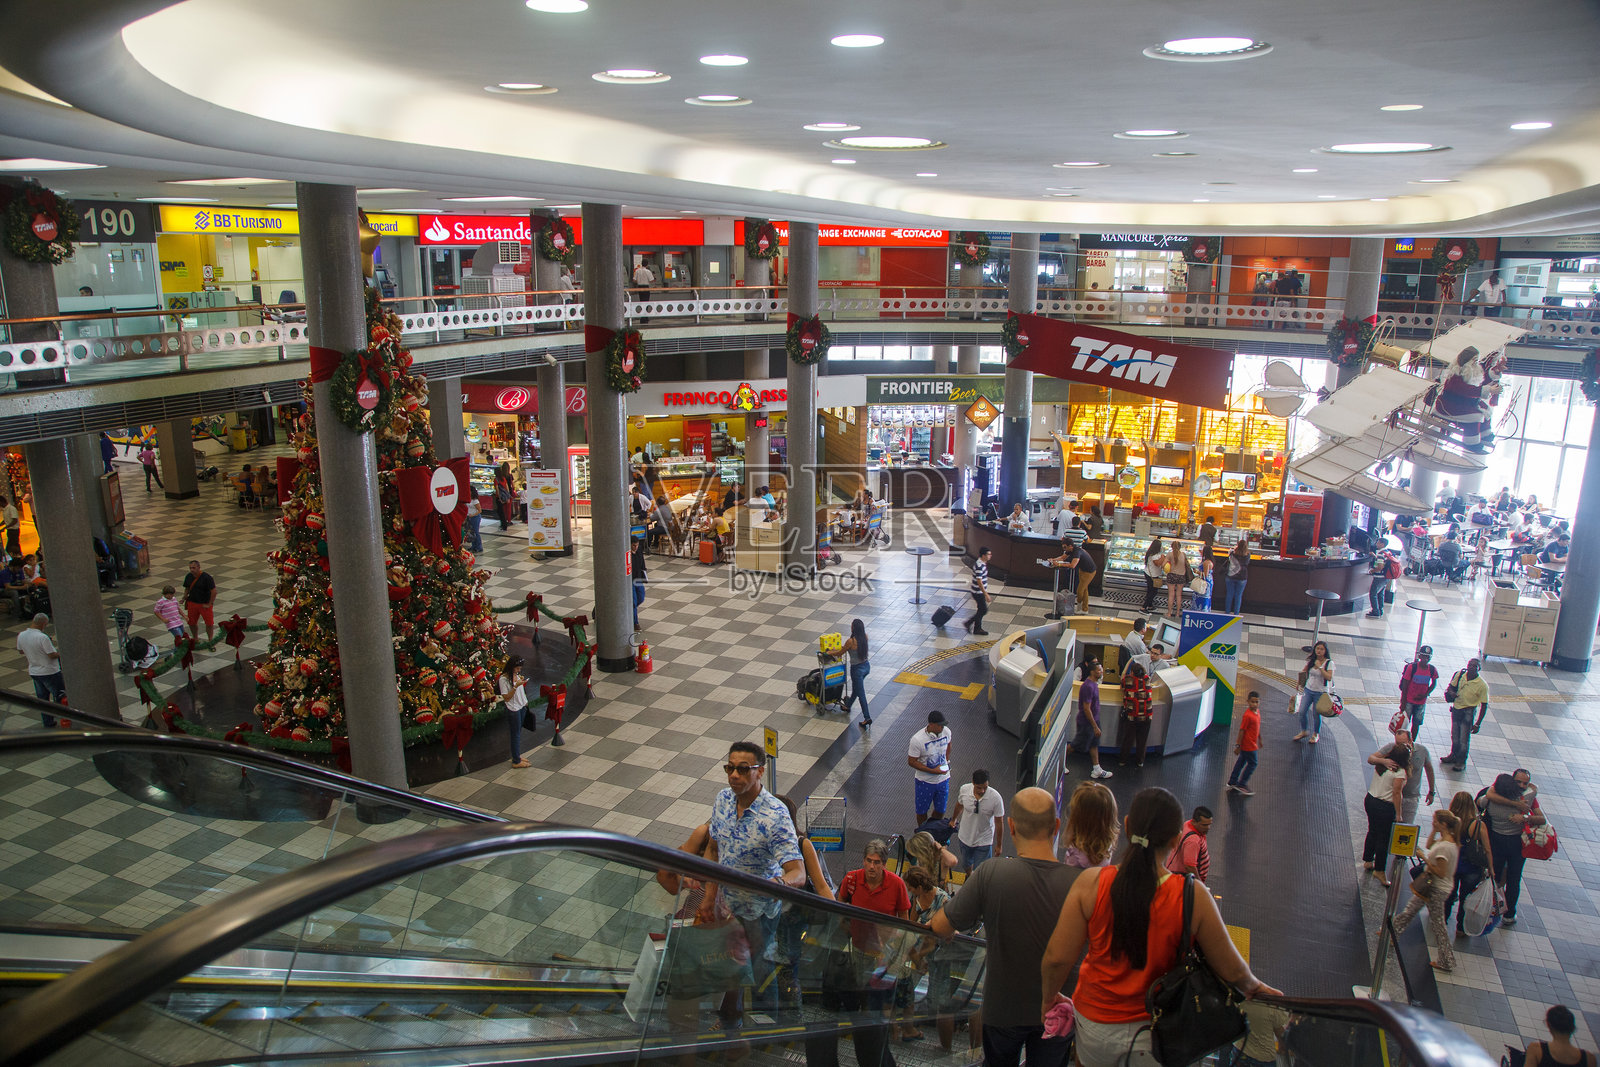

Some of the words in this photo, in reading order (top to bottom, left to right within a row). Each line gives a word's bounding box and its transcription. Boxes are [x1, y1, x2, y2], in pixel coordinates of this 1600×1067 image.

[84, 207, 136, 237] 190
[213, 213, 232, 228] BB
[368, 220, 399, 232] rocard
[454, 222, 532, 241] Santande
[818, 229, 840, 238] ANGE
[842, 229, 886, 238] EXCHANGE
[903, 229, 943, 239] COTAÇÃO
[1100, 233, 1156, 243] MANICURE
[1395, 242, 1414, 252] Itaú
[1086, 259, 1107, 268] BARBA
[1070, 336, 1178, 389] TAM
[357, 389, 378, 400] TAM
[880, 381, 954, 395] FRONTIER
[948, 387, 977, 401] Beer
[663, 391, 732, 407] FRANGO
[760, 388, 788, 403] ASS
[1209, 653, 1236, 661] INFRAERO
